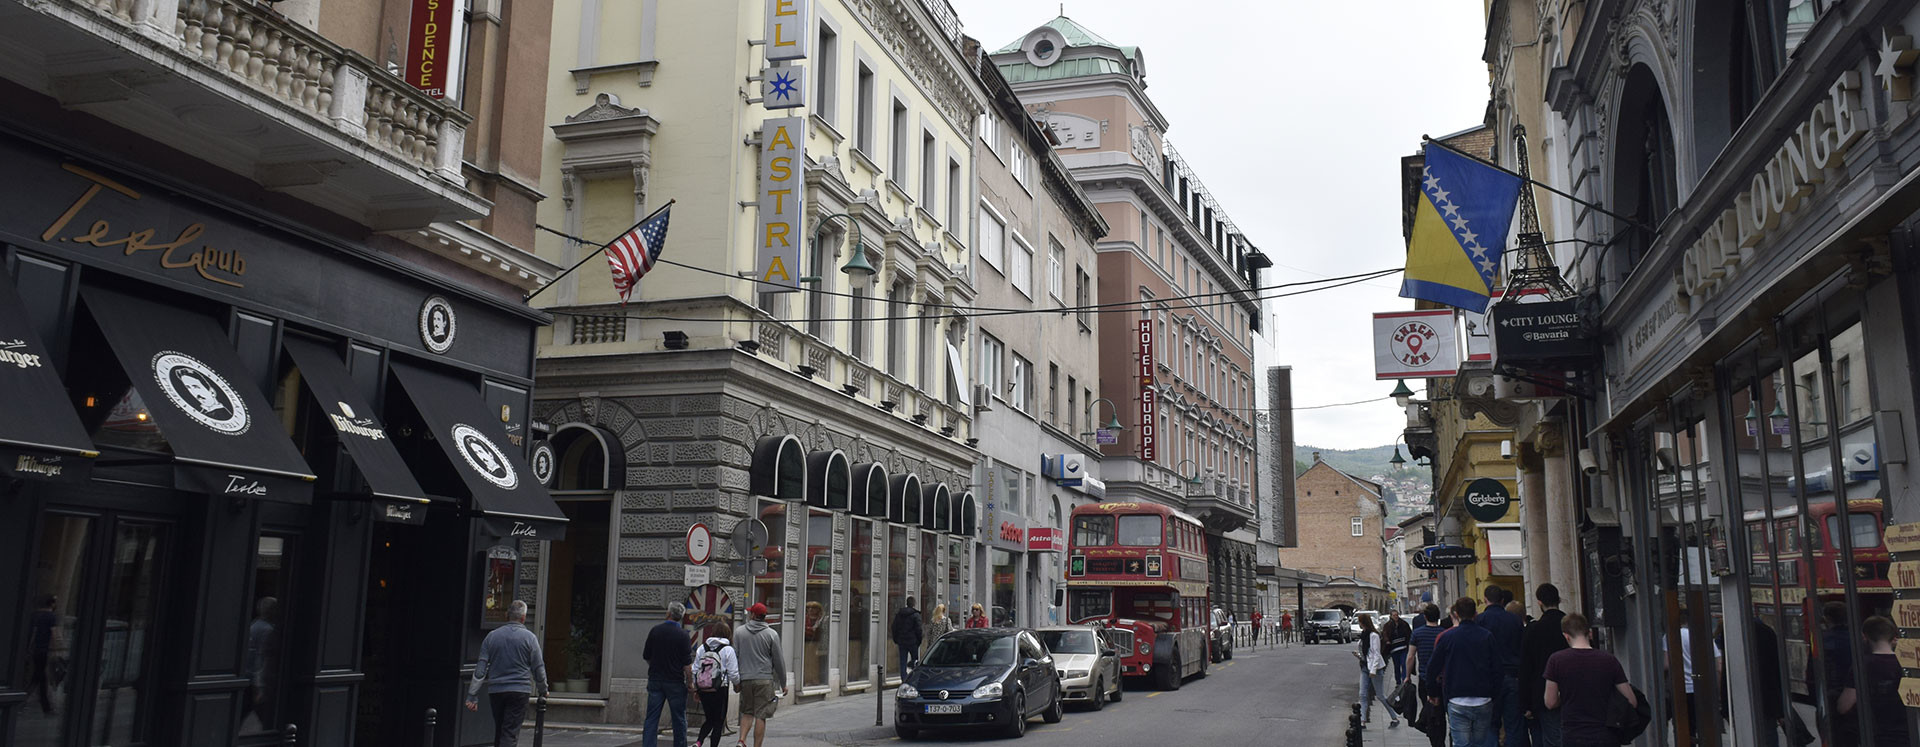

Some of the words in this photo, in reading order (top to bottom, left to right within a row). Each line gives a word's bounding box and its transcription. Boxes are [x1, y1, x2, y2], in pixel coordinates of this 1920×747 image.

[421, 88, 443, 96] TEL
[1682, 209, 1738, 297] CITY
[1734, 70, 1866, 249] LOUNGE
[763, 125, 795, 282] ASTRA
[41, 163, 244, 288] Tesla
[203, 245, 246, 276] pub
[1509, 316, 1534, 327] CITY
[1538, 313, 1580, 325] LOUNGE
[1394, 323, 1435, 343] CHECK
[1533, 330, 1569, 340] Bavaria
[1141, 322, 1150, 376] HOTEL
[1402, 352, 1431, 365] INN
[330, 413, 385, 440] Bitburger
[1143, 391, 1152, 459] EUROPE
[16, 455, 62, 477] Bitburger
[225, 474, 266, 496] Tesla
[1468, 491, 1505, 506] Carlsberg
[1897, 563, 1916, 587] fun
